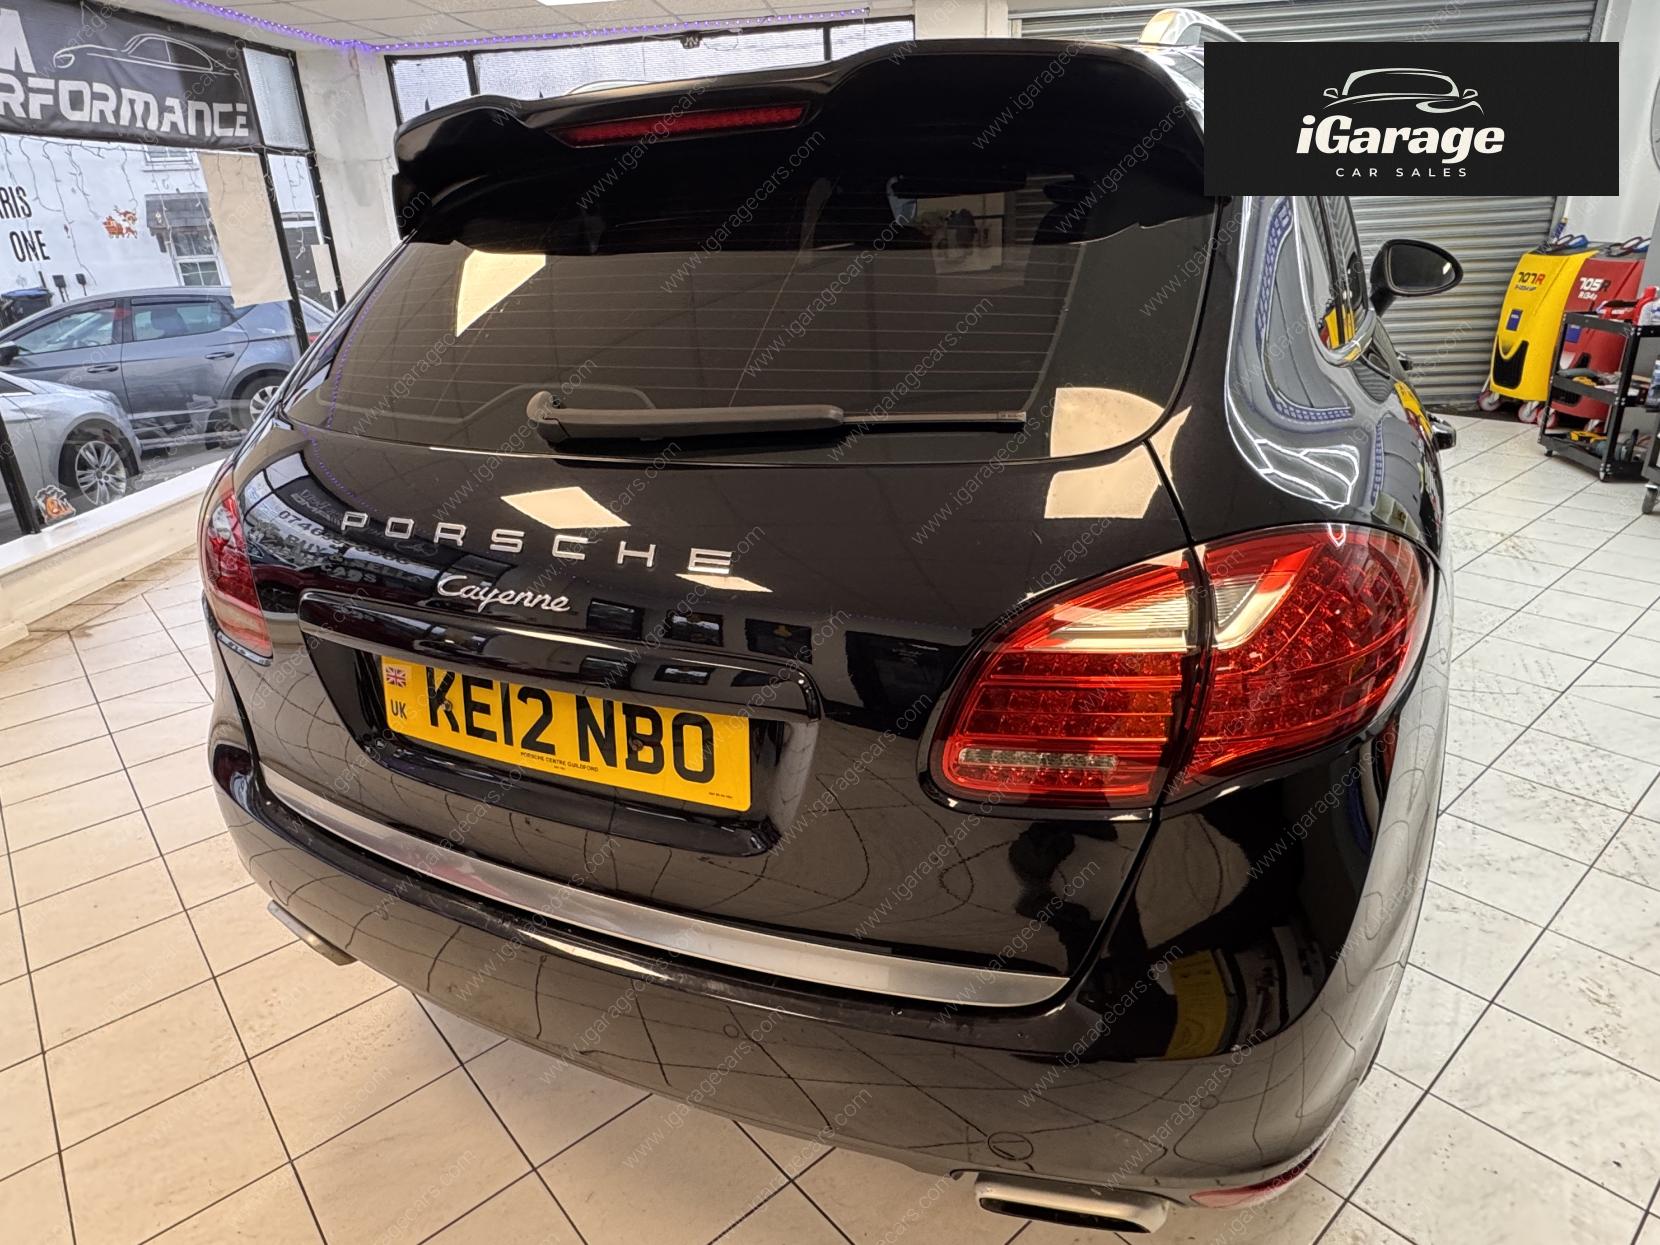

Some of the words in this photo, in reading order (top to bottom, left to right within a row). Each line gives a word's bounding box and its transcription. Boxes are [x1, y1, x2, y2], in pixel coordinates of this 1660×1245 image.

[0, 186, 32, 219] RIS
[9, 230, 51, 263] ONE
[1518, 271, 1546, 285] 707R
[1579, 277, 1612, 292] 705R
[341, 510, 734, 576] PORSCHE
[437, 574, 571, 615] Cayenne
[390, 699, 408, 721] UK
[425, 666, 557, 756] KE12
[575, 692, 717, 784] NBO
[520, 751, 545, 763] PORSCHE
[545, 756, 567, 767] CENTRE
[567, 761, 599, 773] GUILDFORD
